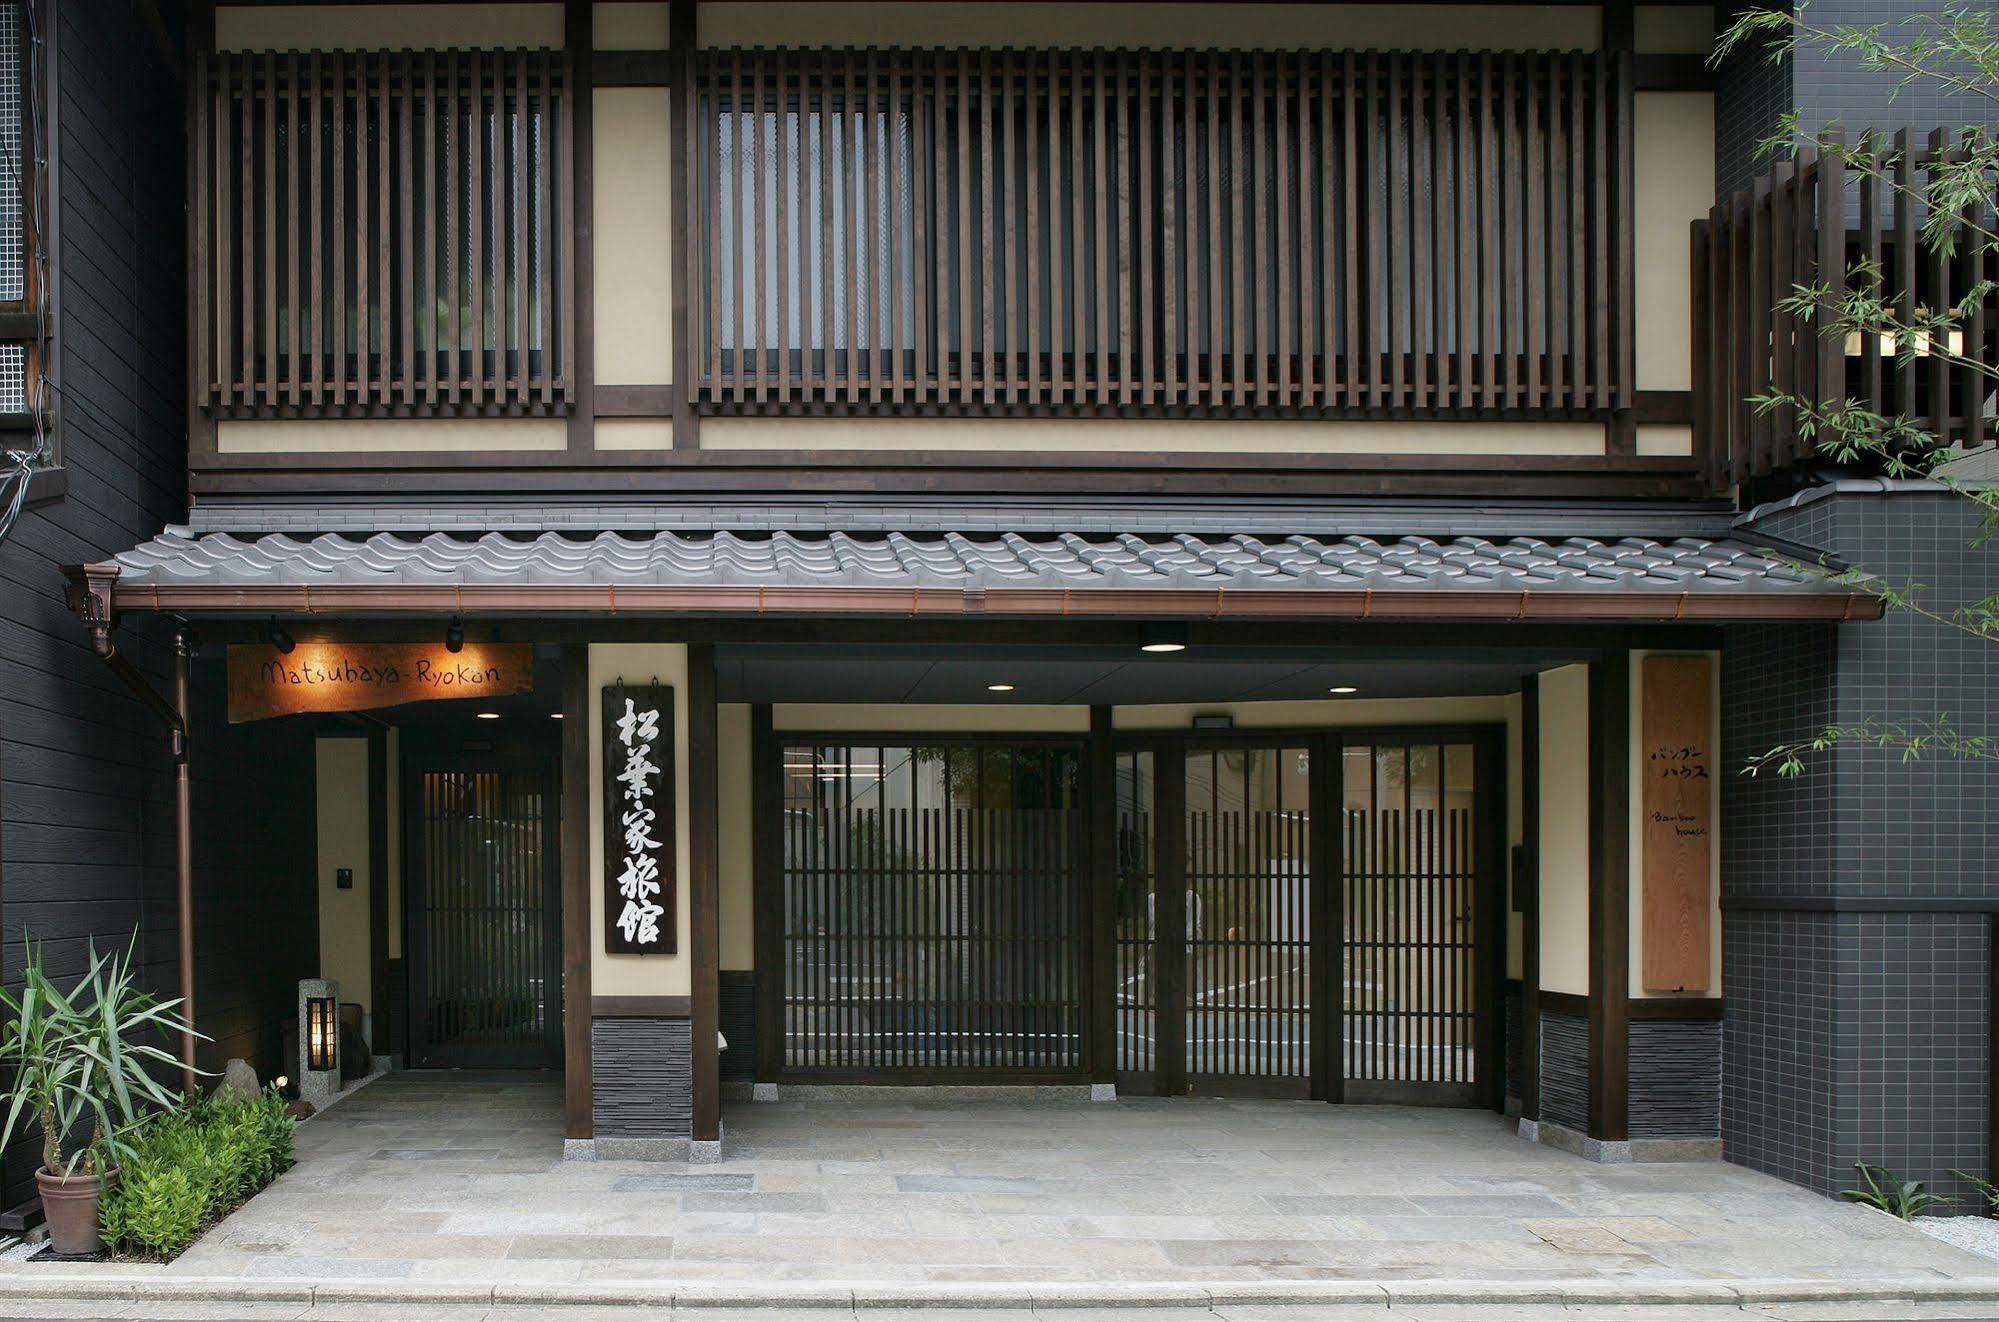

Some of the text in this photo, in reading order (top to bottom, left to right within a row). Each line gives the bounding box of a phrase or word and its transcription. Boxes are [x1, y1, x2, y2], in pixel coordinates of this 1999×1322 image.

[416, 659, 501, 687] Ryokan
[1651, 746, 1702, 760] バンブー
[1664, 765, 1708, 779] ハウス
[617, 698, 664, 944] 松葉家旅館
